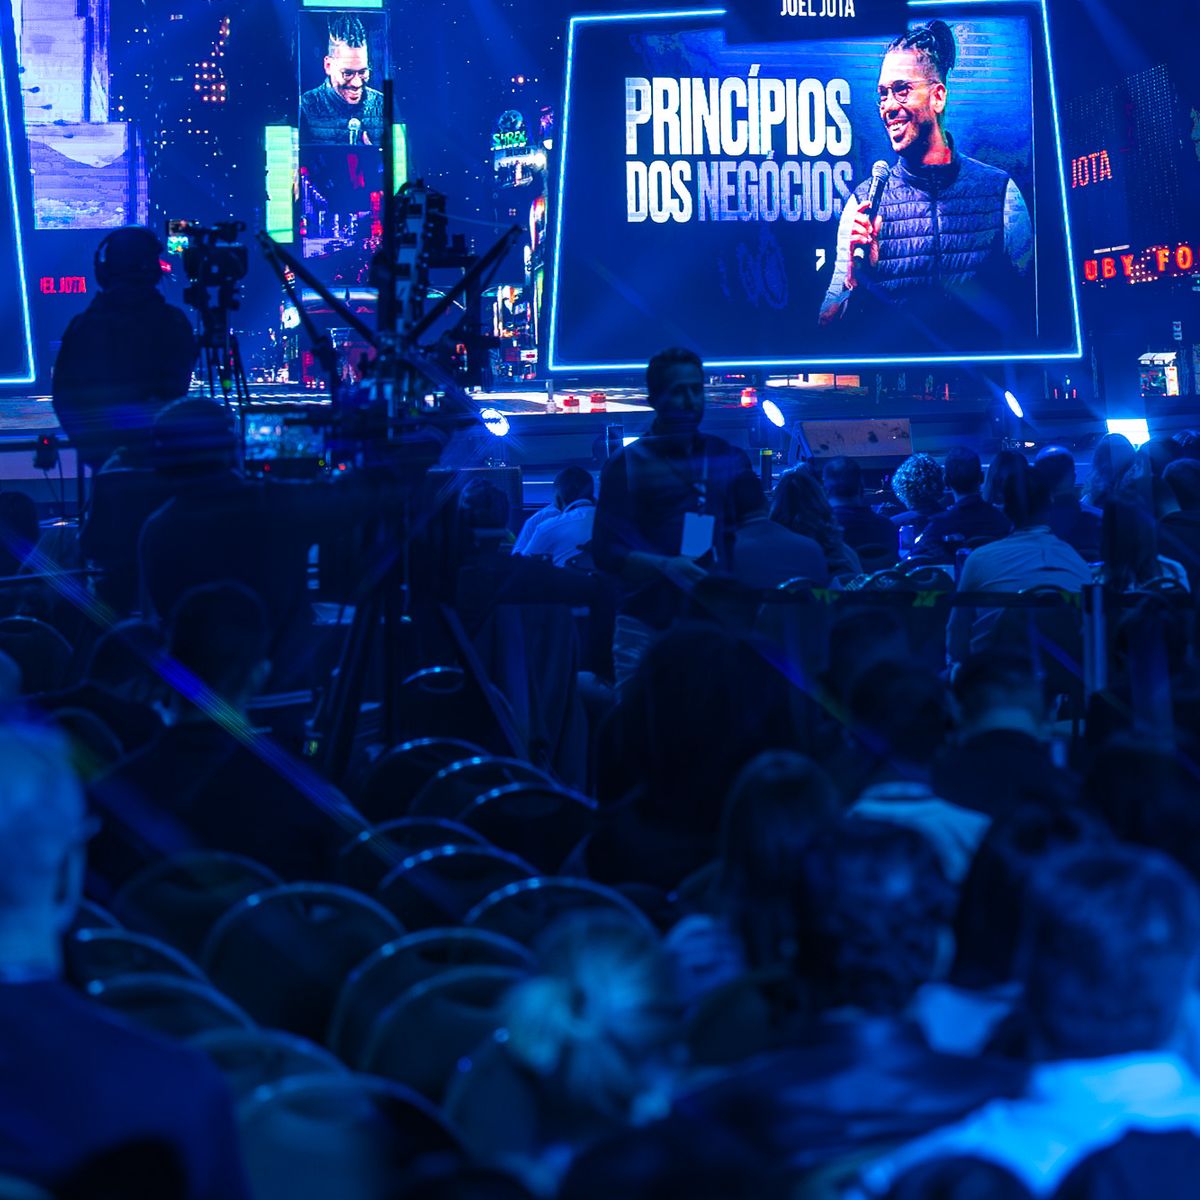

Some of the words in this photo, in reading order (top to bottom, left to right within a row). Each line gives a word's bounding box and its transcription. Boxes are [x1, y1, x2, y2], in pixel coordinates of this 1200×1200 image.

[625, 64, 852, 156] PRINCÍPIOS
[626, 160, 693, 223] DOS
[697, 150, 853, 222] NEGÓCIOS
